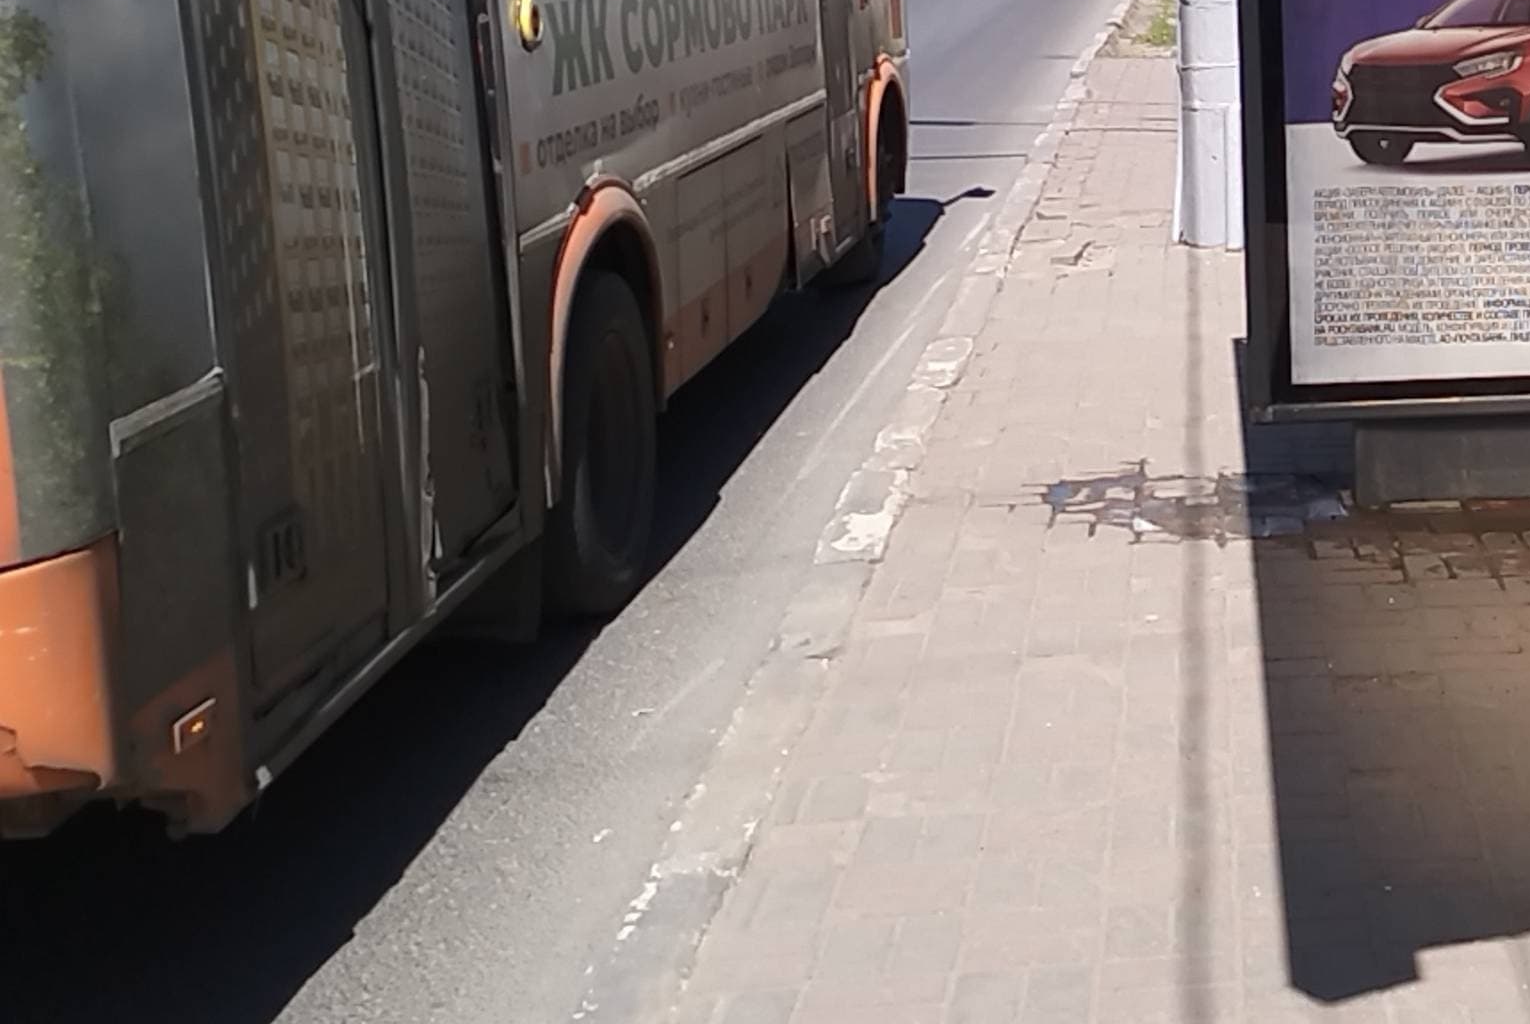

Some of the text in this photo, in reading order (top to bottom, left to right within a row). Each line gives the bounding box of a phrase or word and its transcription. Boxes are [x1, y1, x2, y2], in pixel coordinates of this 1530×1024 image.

[536, 121, 598, 169] отделка
[601, 113, 617, 141] на
[619, 93, 661, 137] выбор
